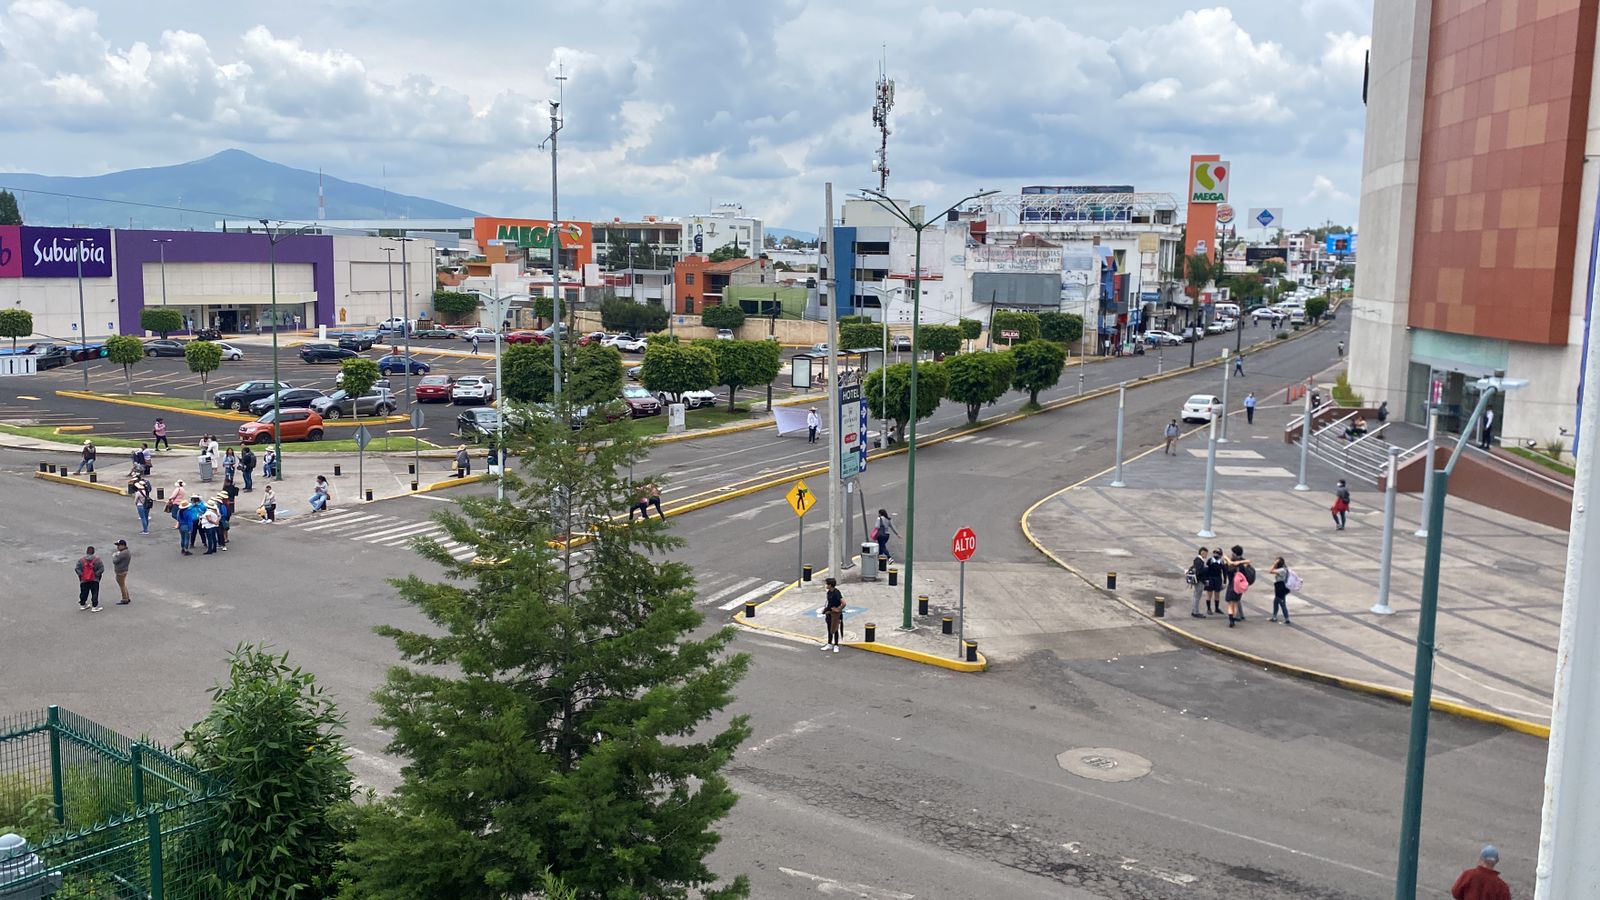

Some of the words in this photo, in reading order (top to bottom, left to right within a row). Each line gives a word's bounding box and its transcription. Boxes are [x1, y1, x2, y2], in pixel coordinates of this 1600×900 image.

[497, 225, 562, 248] MEGA
[33, 237, 105, 266] Suburbia
[843, 388, 859, 400] HOTEL
[954, 536, 975, 552] ALTO
